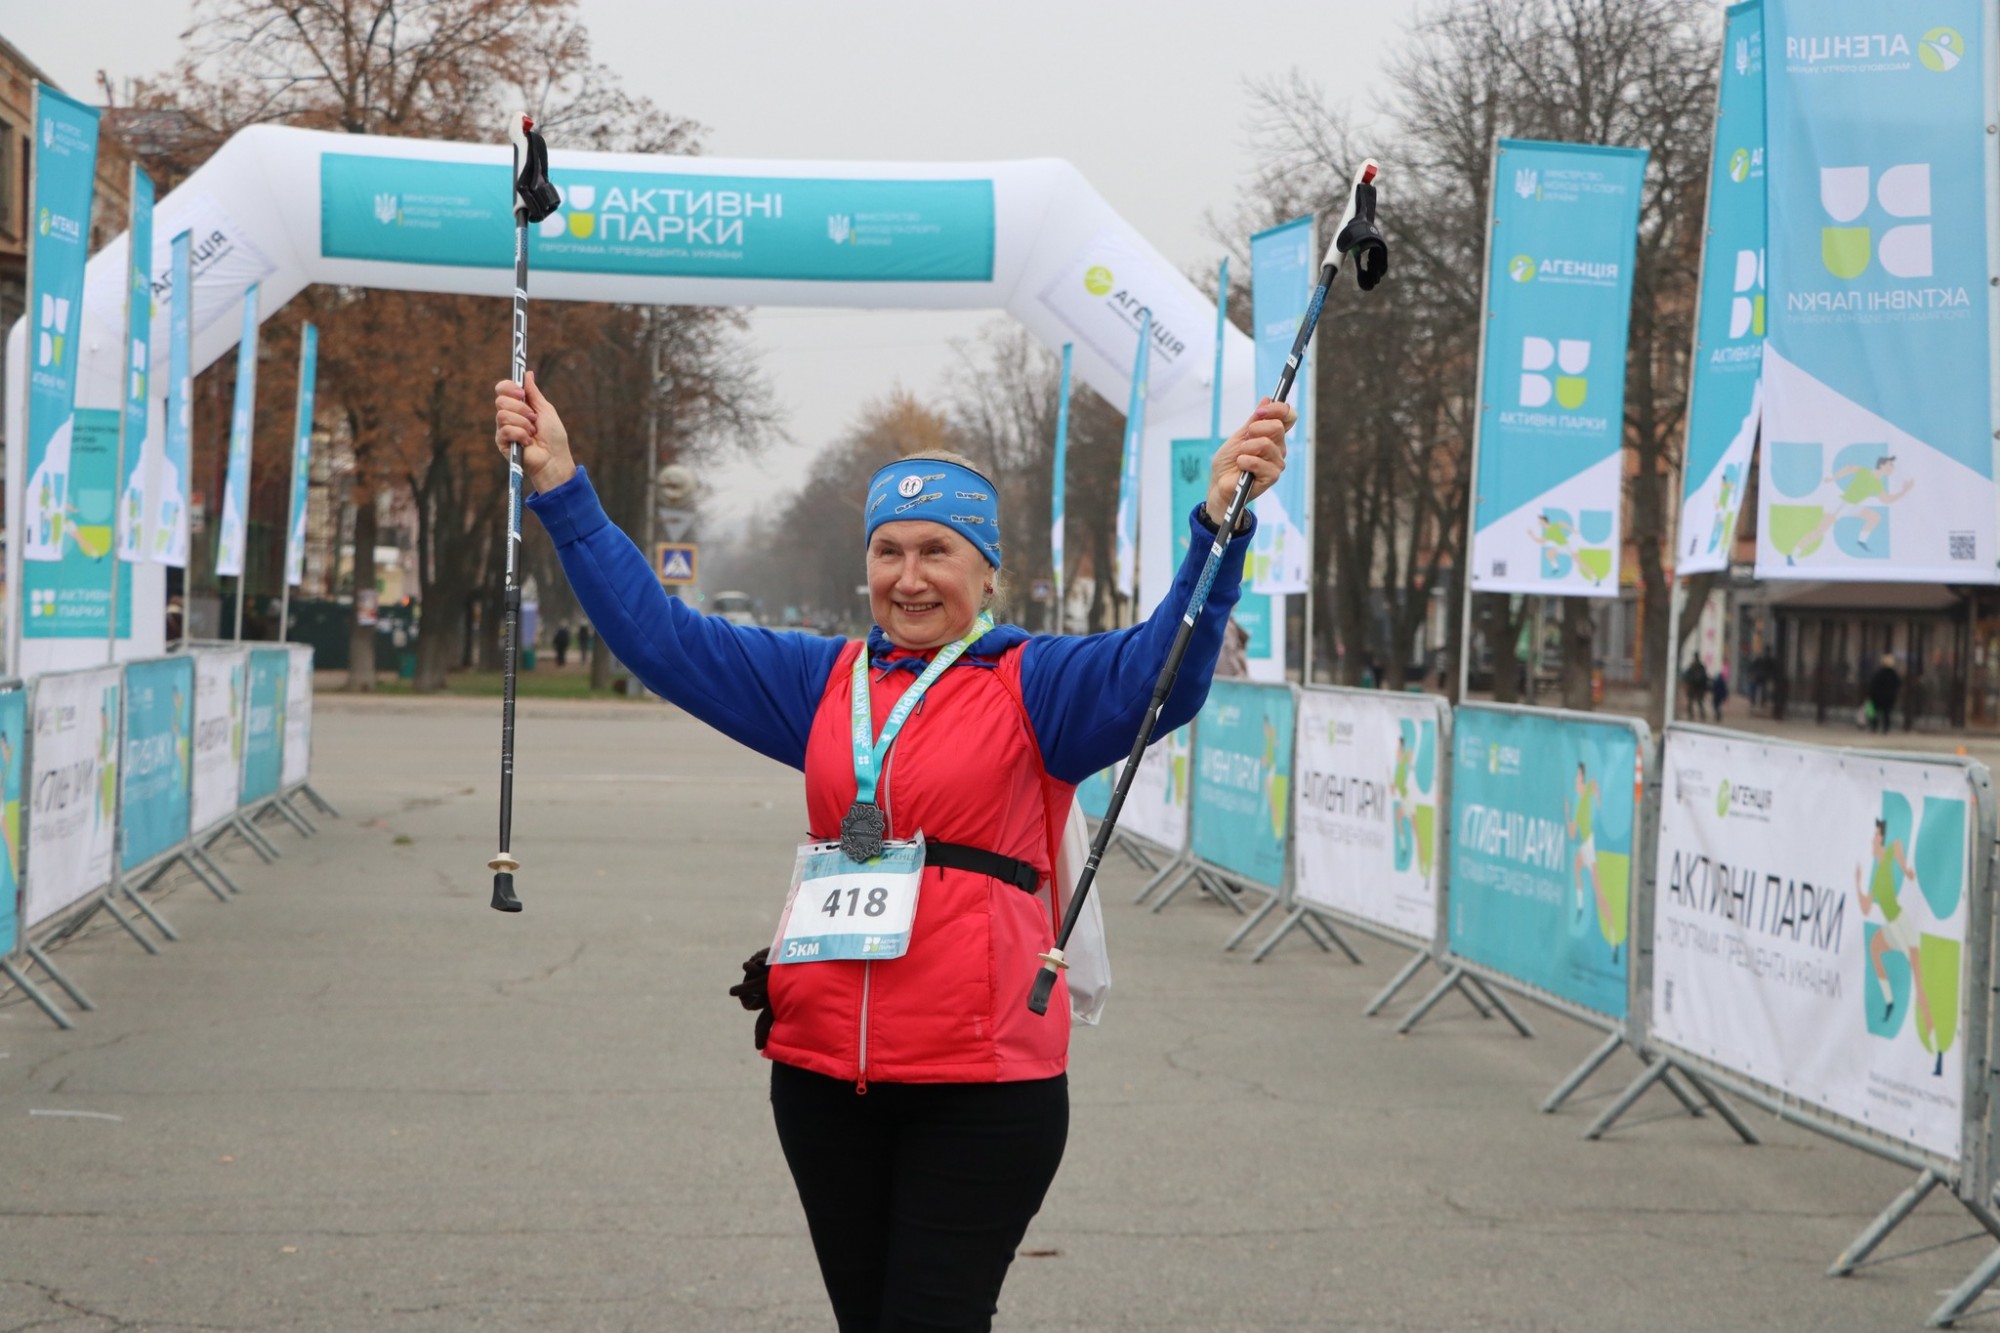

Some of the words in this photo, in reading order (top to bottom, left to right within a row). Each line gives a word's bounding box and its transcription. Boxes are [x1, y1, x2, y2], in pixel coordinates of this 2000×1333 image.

[601, 186, 784, 219] АКТИВНІ
[600, 212, 745, 247] ПАРКИ
[1538, 259, 1619, 279] АГЕНЦІЯ
[923, 639, 967, 682] АКТИВНІ
[889, 682, 926, 725] ПАРКИ
[821, 887, 889, 918] 418
[1759, 872, 1846, 955] ПАРКИ
